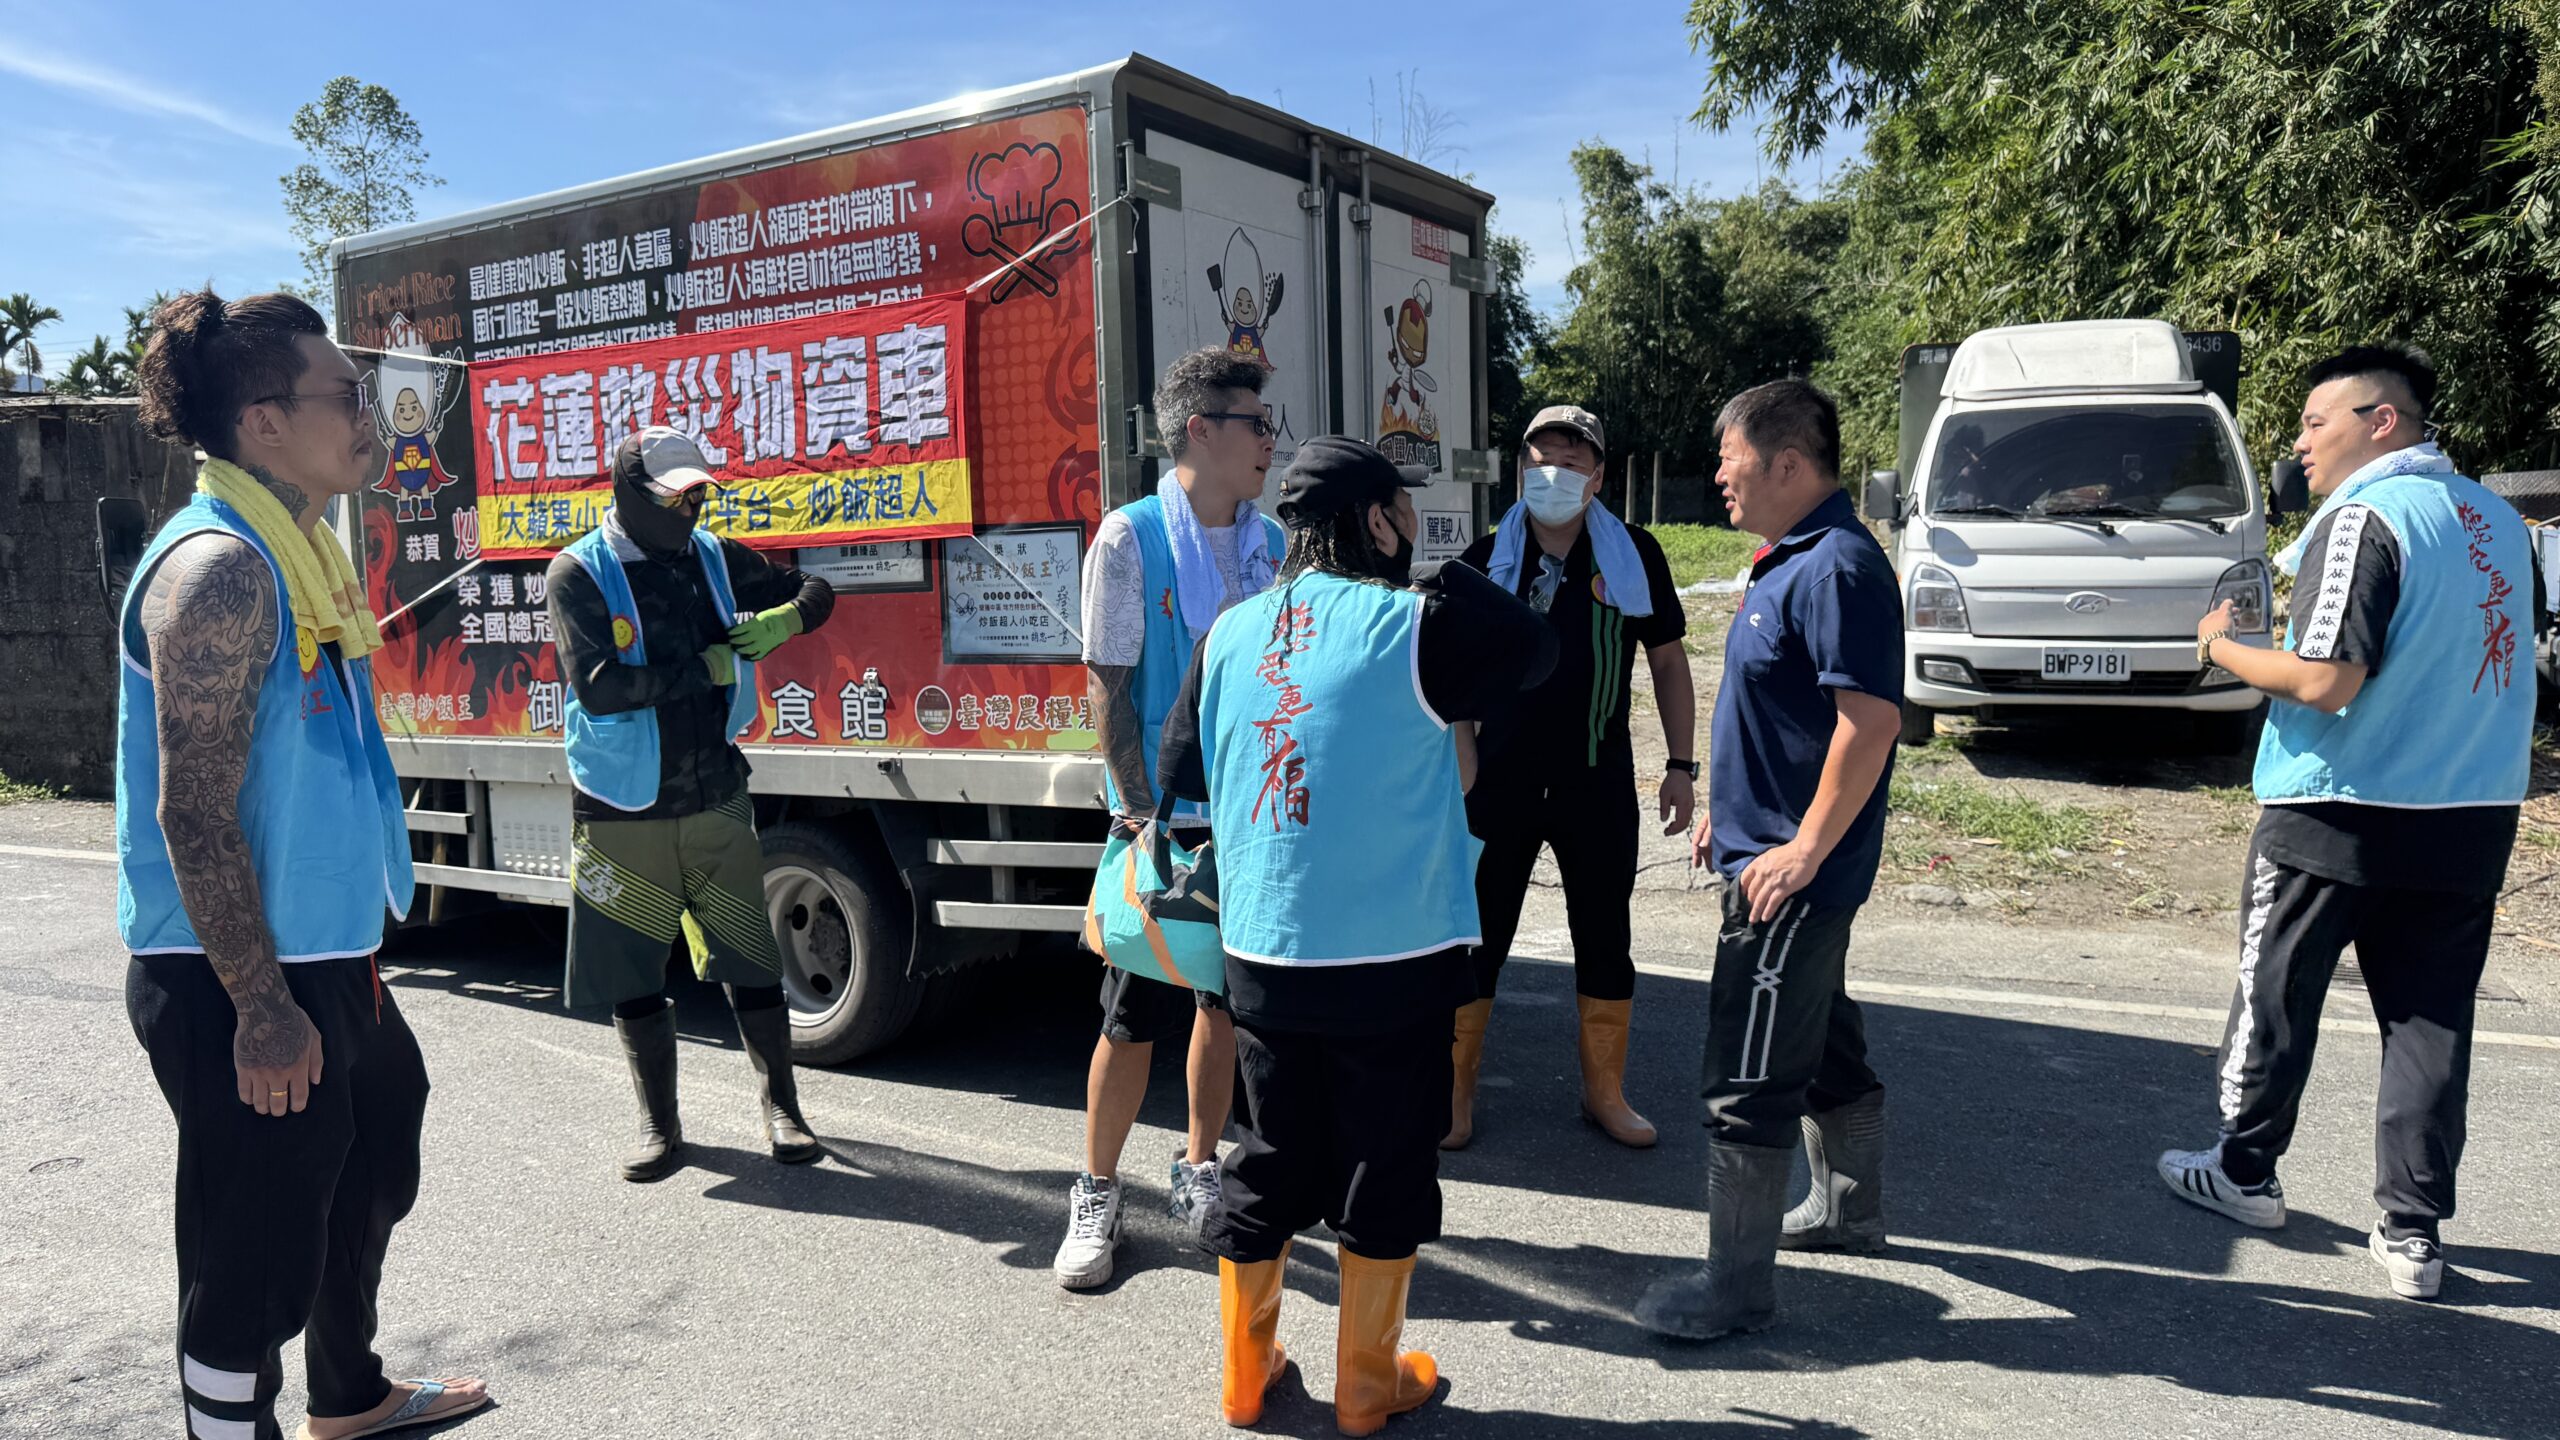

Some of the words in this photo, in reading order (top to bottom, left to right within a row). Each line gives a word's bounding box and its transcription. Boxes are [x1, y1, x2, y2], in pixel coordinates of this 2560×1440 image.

[356, 275, 408, 318] Fried
[411, 272, 456, 307] Rice
[354, 313, 463, 351] Superman
[482, 322, 950, 482] 花蓮救災物資車
[1426, 516, 1467, 545] 駕駛人
[405, 533, 441, 562] 恭賀
[978, 615, 1049, 628] 炒飯超人小吃店
[380, 692, 474, 722] 臺灣炒飯王
